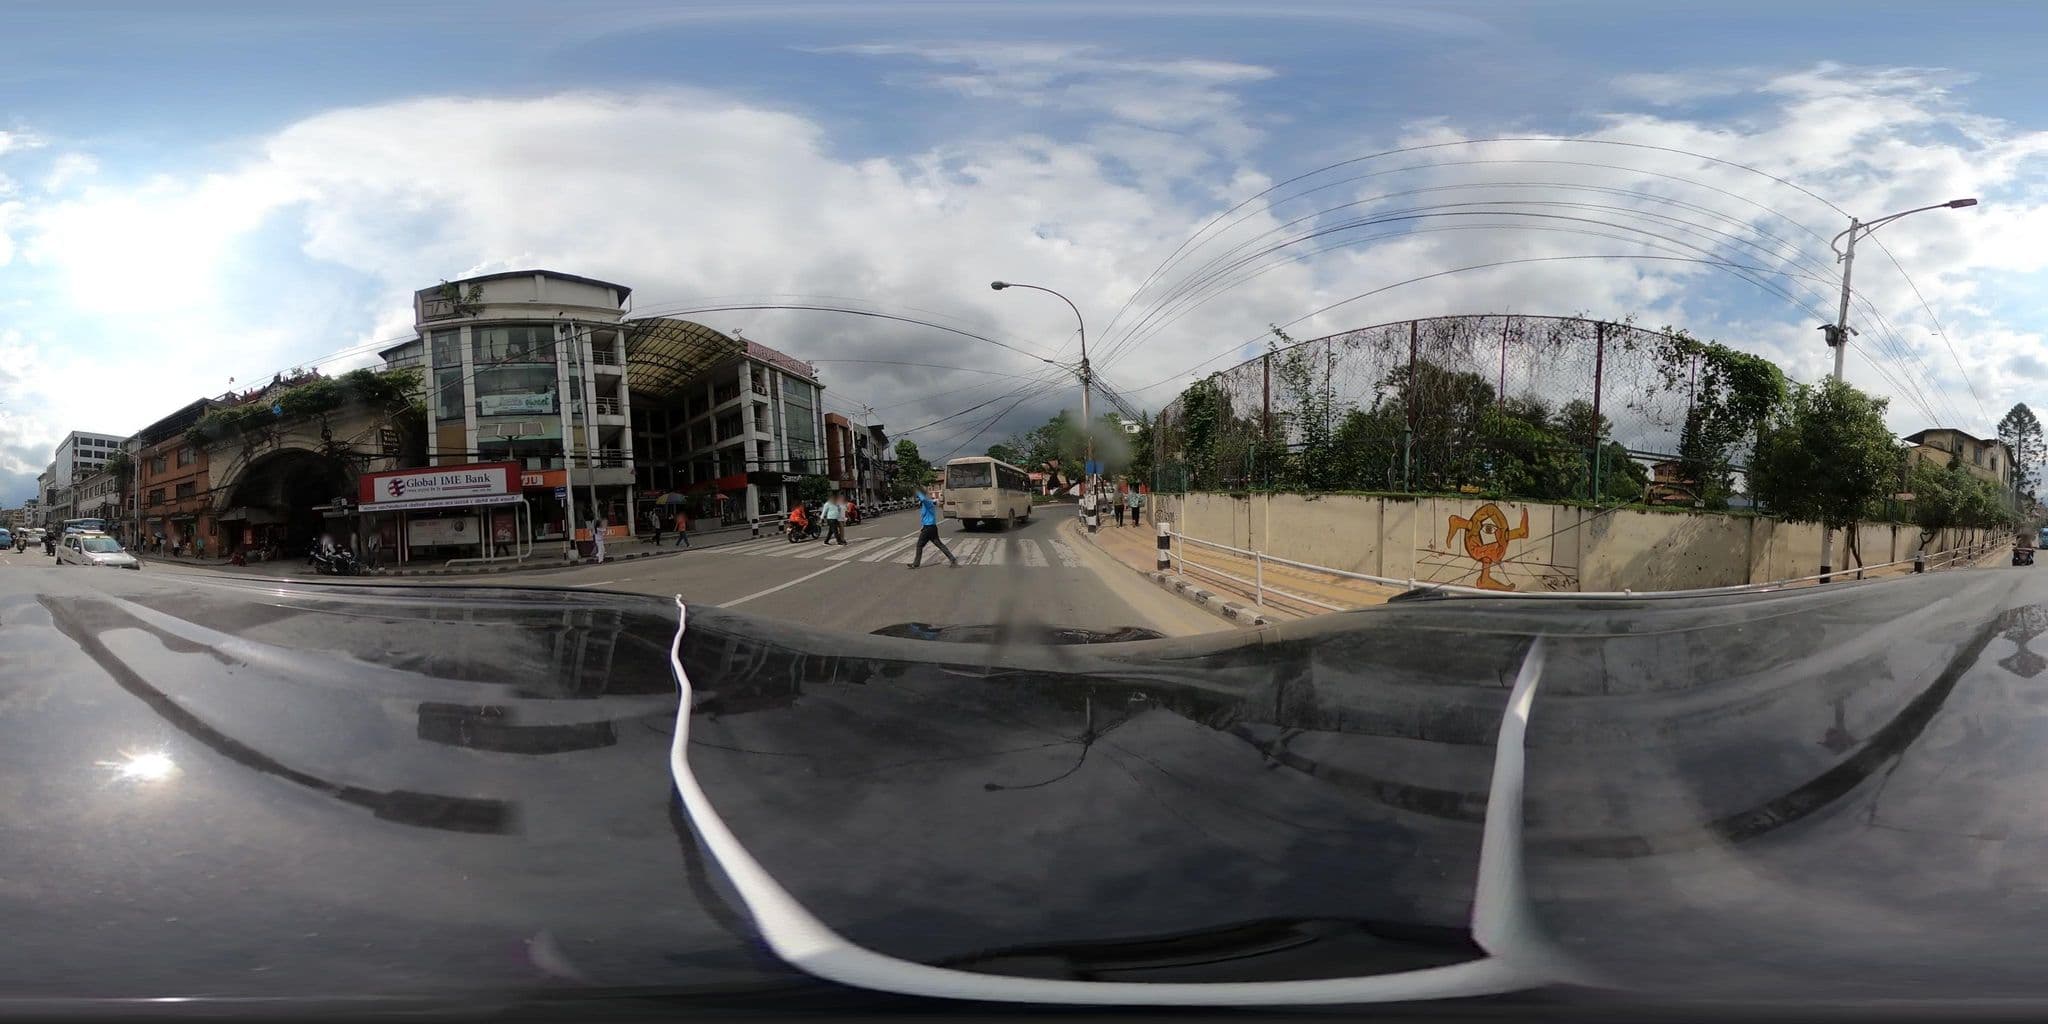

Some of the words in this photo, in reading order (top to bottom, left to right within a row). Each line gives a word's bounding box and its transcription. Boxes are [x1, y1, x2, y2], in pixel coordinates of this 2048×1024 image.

[406, 477, 437, 487] Global
[440, 475, 461, 485] IME
[465, 473, 491, 483] Bank
